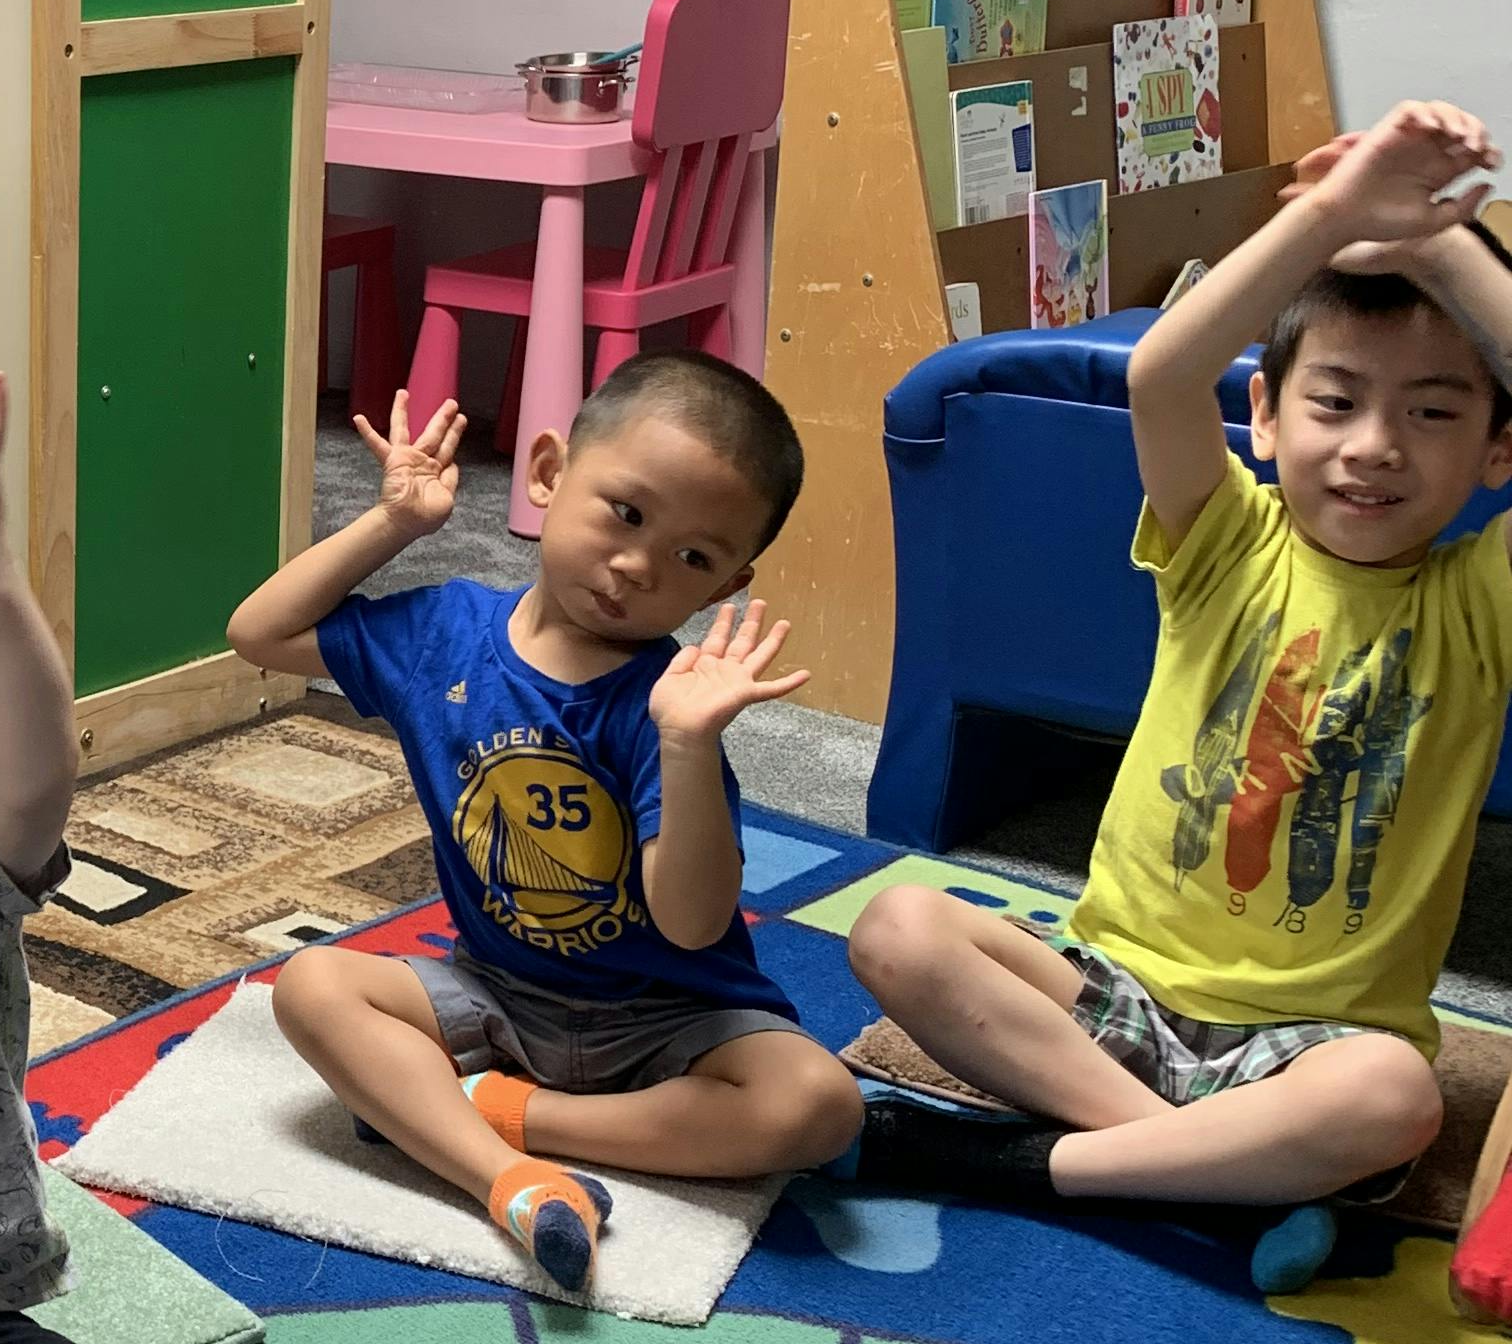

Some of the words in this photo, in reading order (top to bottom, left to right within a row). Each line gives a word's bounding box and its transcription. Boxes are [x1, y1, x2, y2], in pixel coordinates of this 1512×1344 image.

[1146, 79, 1154, 118] I
[1157, 73, 1186, 116] SPY
[457, 727, 544, 780] GOLDEN
[526, 784, 591, 832] 35
[1226, 893, 1246, 916] 9
[1343, 913, 1364, 935] 9
